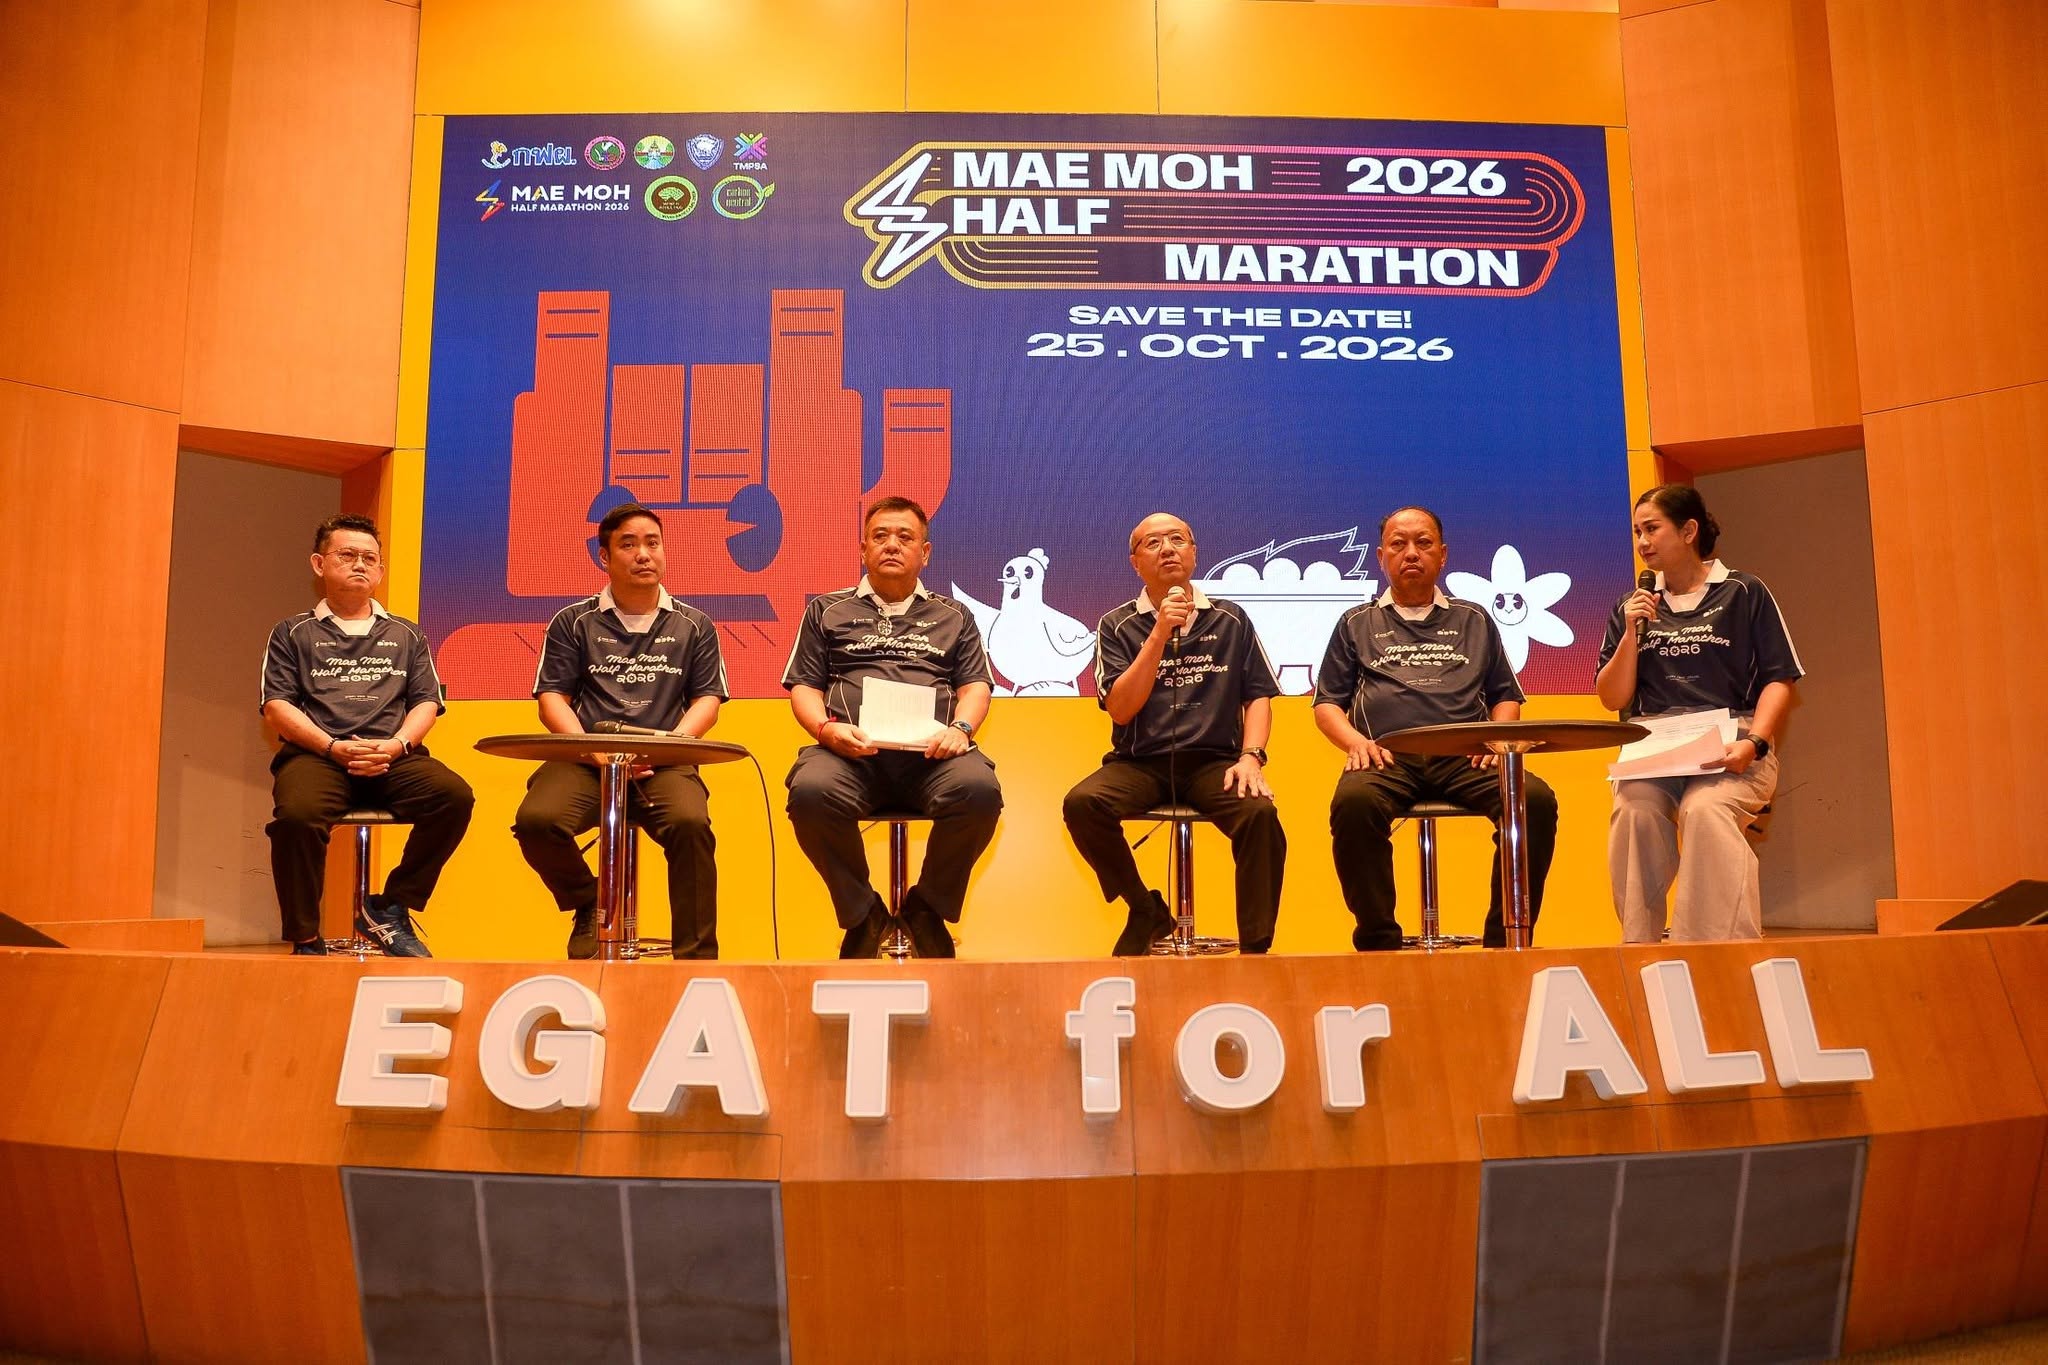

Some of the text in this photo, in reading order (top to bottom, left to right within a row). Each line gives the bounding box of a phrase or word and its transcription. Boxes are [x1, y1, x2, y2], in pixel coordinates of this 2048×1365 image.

[943, 152, 1253, 191] MAE MOH
[1346, 156, 1507, 196] 2026
[511, 184, 631, 201] MAE MOH
[511, 202, 629, 212] HALF MARATHON 2026
[953, 197, 1110, 235] HALF
[1164, 244, 1520, 287] MARATHON
[1068, 305, 1413, 329] SAVE THE DATE!
[1026, 332, 1105, 357] 25
[1140, 333, 1265, 358] OCT
[1300, 335, 1454, 361] 2026
[884, 641, 946, 657] Marathon
[1667, 634, 1731, 647] Marathon
[1659, 644, 1701, 657] 2026
[311, 666, 407, 677] Half Marathon
[588, 664, 683, 675] Half Marathon
[616, 673, 656, 683] 2026
[336, 957, 1874, 1118] EGAT for ALL
